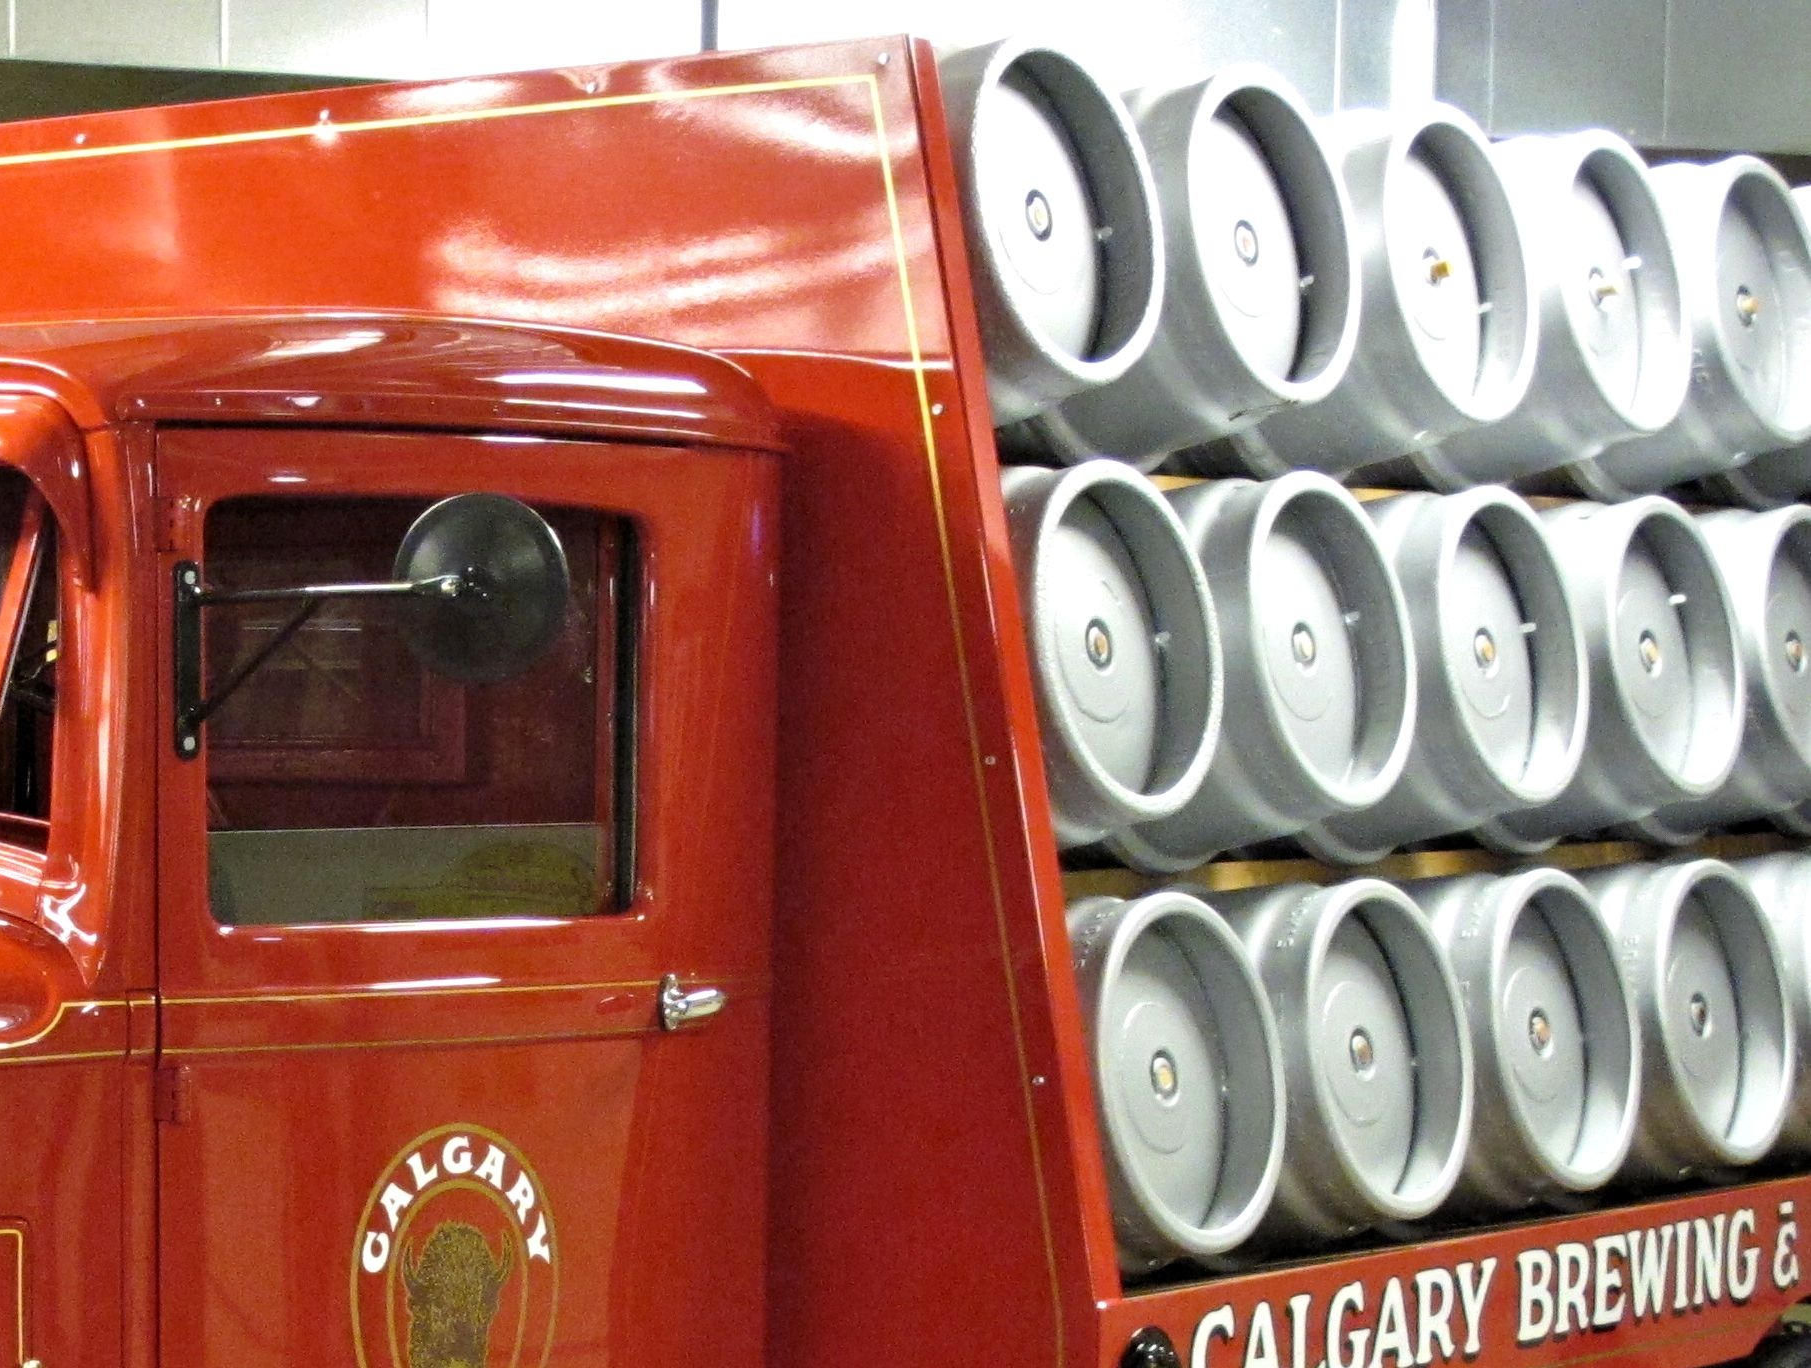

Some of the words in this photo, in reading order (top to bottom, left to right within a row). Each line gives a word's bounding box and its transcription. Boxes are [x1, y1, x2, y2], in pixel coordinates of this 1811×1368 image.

[362, 1136, 550, 1273] CALGARY
[1515, 1208, 1762, 1343] BREWING
[1774, 1201, 1799, 1287] &
